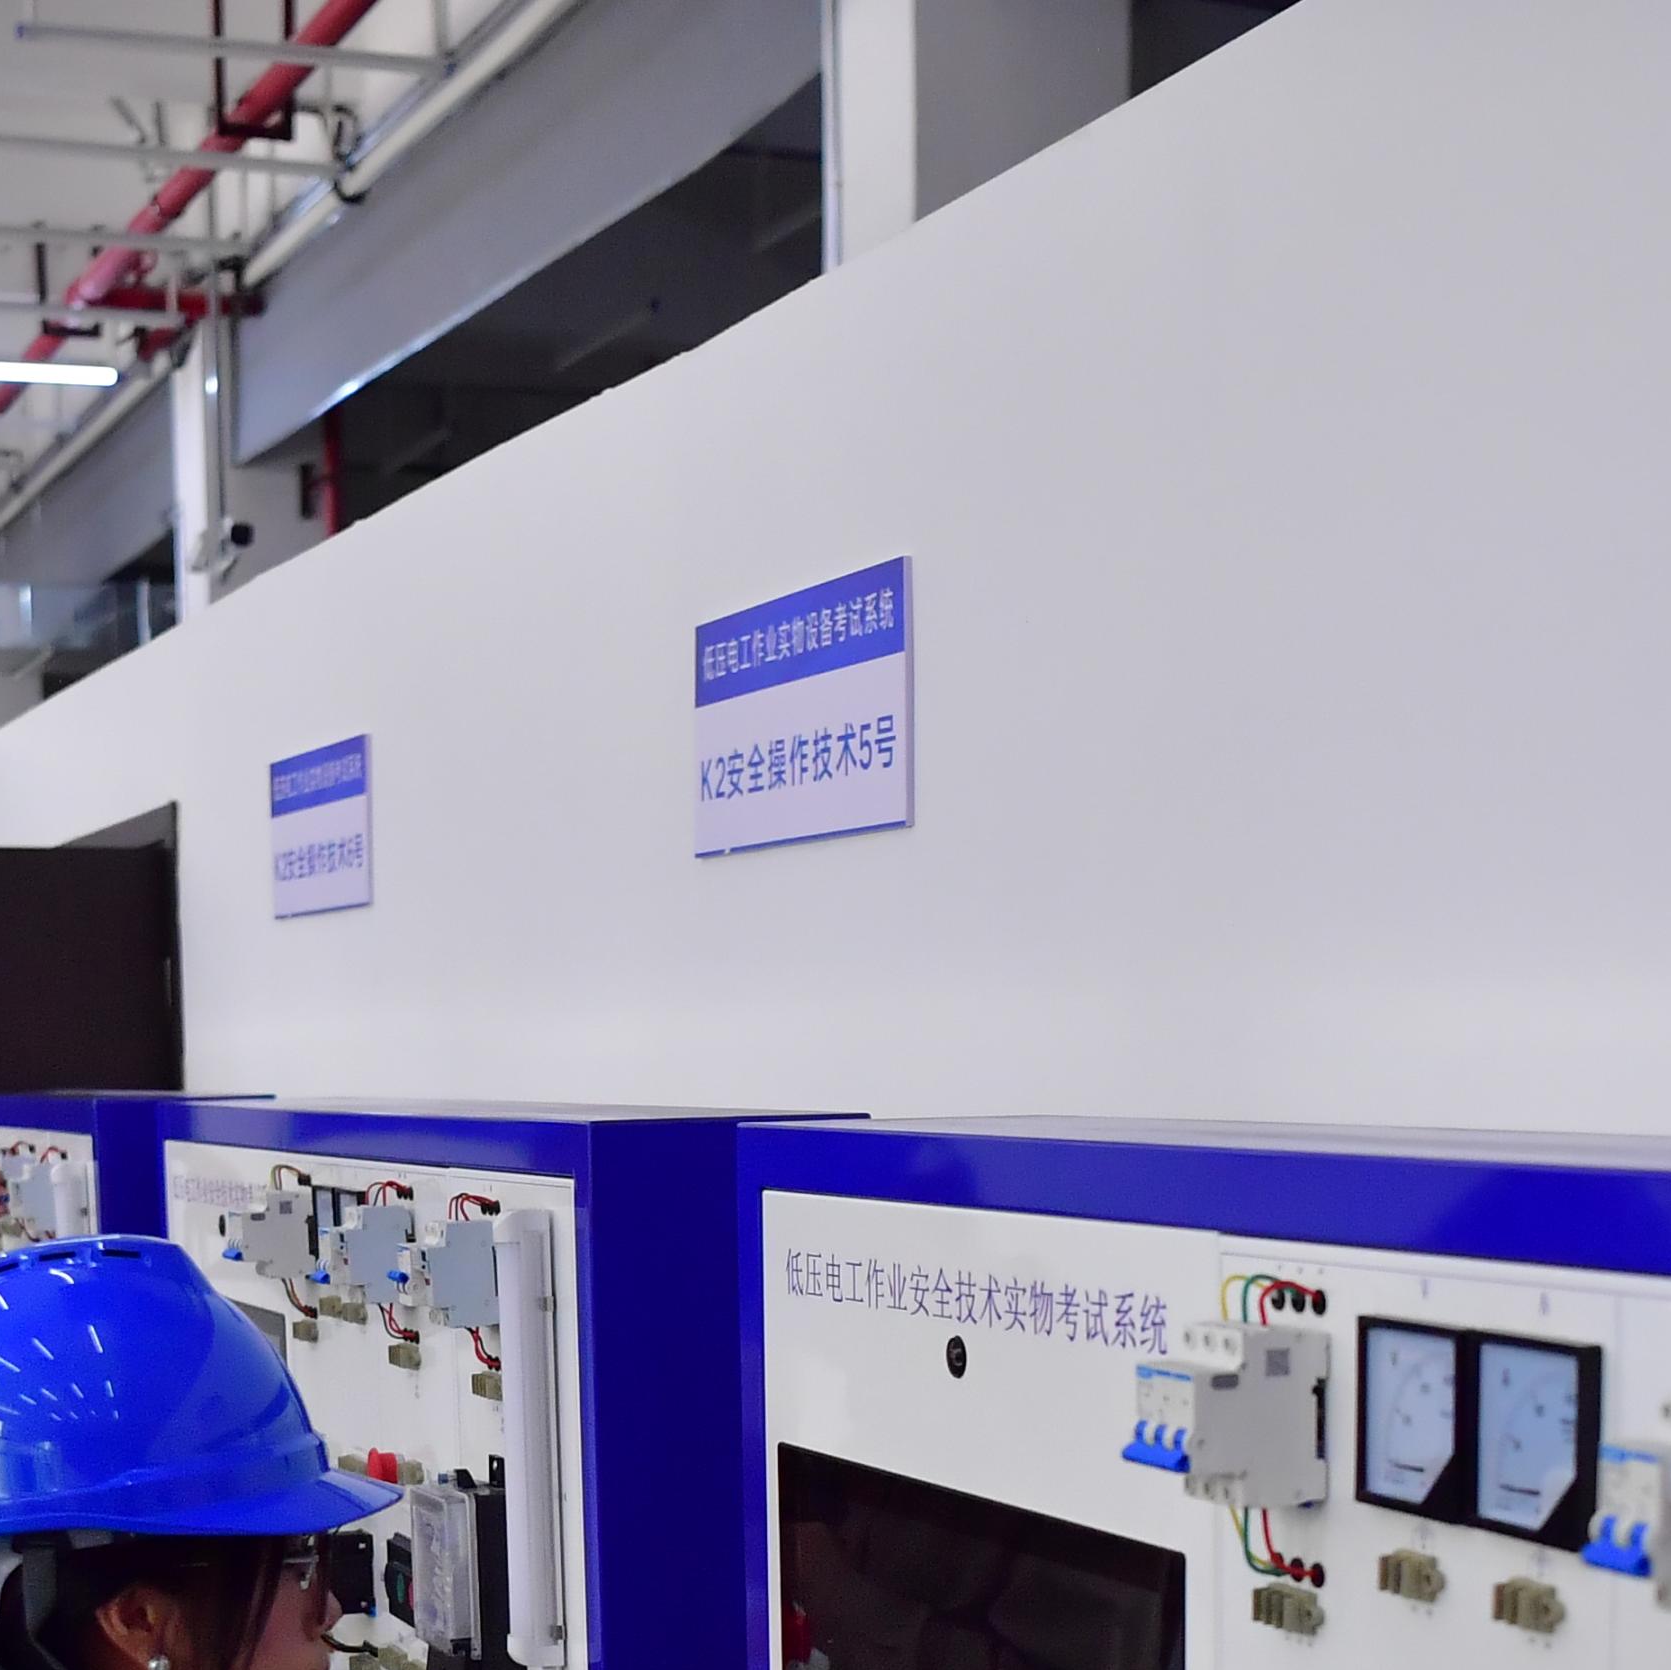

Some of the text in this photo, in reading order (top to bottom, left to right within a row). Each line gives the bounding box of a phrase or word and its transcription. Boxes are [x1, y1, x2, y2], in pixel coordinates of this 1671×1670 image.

[702, 587, 895, 682] 低压电工作业实物设备考试系统
[700, 714, 897, 803] K2安全操作技术5号
[784, 1247, 1169, 1357] 低压电工作业安全技术实物考试系统
